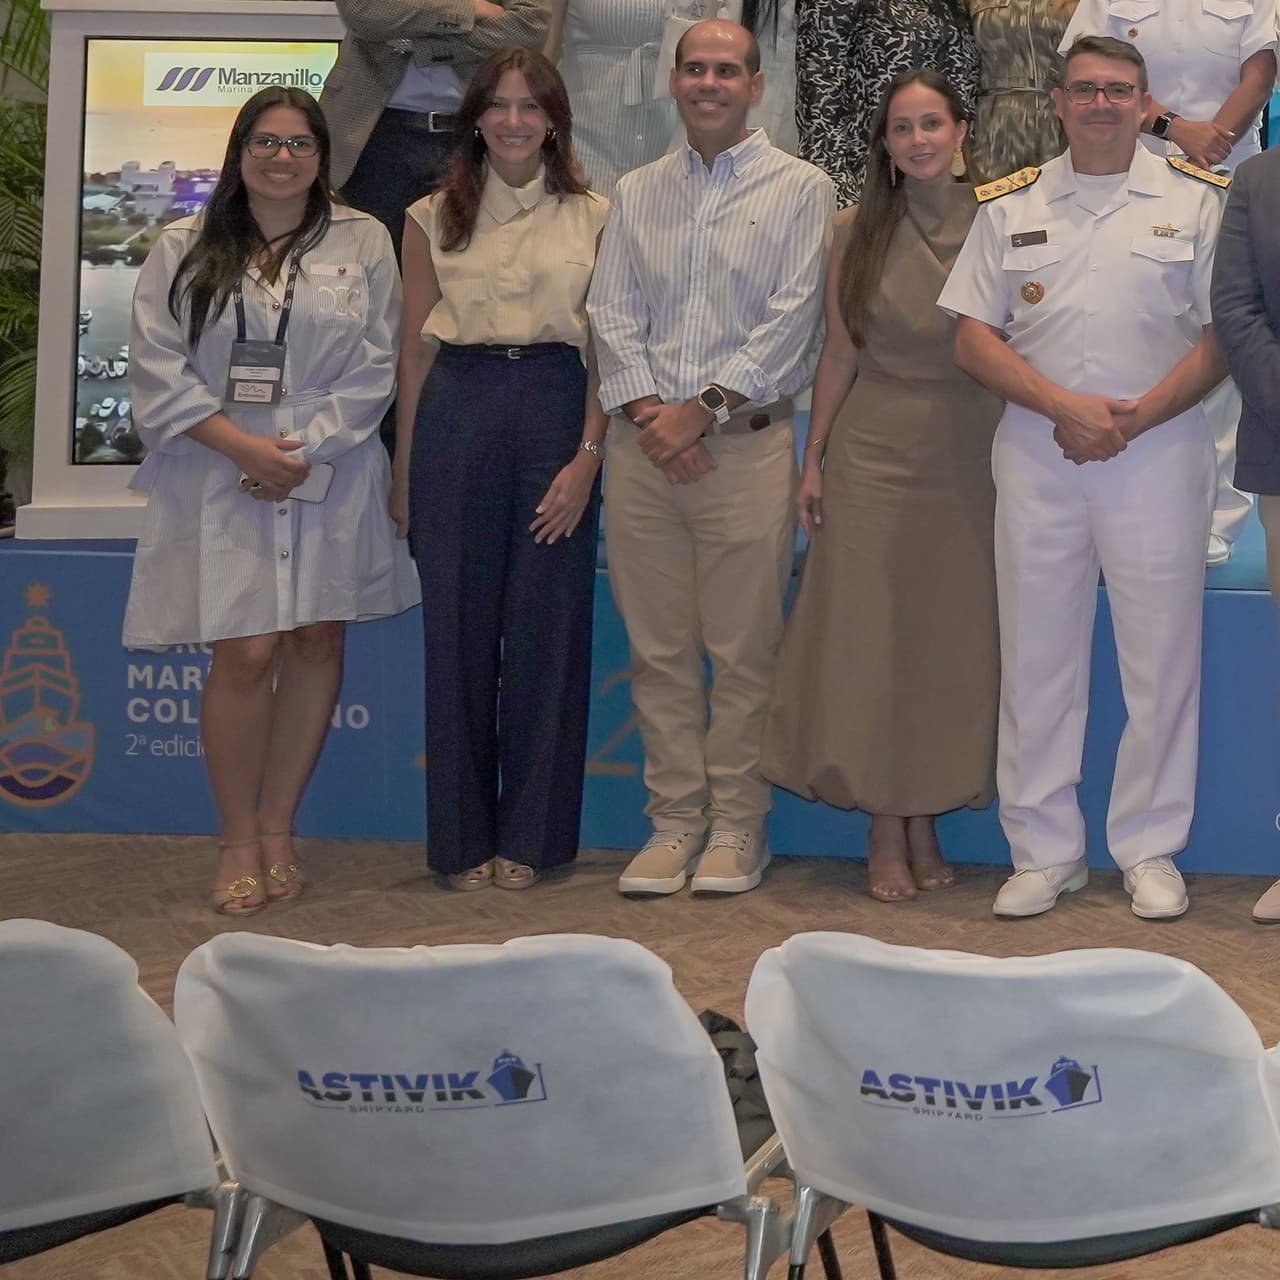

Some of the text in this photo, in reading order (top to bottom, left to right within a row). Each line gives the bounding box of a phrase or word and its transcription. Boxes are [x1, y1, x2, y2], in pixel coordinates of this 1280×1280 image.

[218, 67, 322, 86] Manzanillo
[151, 735, 206, 756] edici
[297, 1069, 487, 1103] ASTIVIK
[860, 1069, 1043, 1111] ASTIVIK
[349, 1105, 425, 1114] SHIPYARD
[912, 1106, 984, 1121] SHIPYARD
